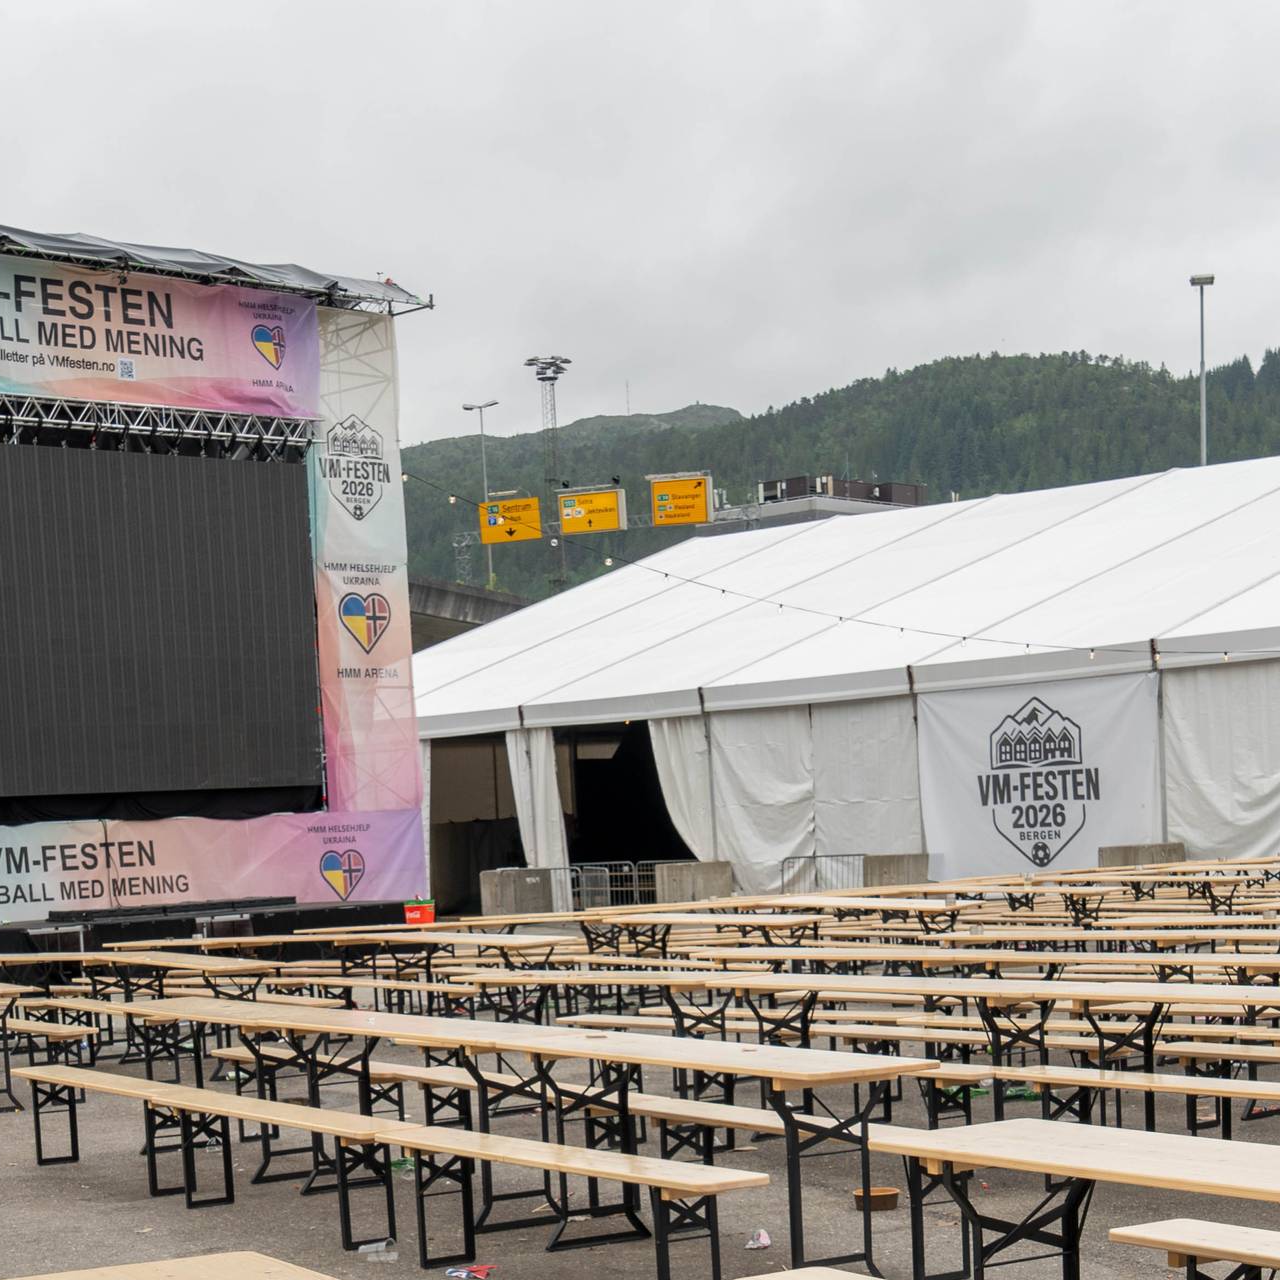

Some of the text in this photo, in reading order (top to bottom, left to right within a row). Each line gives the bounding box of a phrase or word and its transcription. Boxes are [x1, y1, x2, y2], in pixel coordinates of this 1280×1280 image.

[37, 320, 96, 350] MED
[105, 328, 204, 362] MENING
[32, 353, 45, 366] på
[47, 354, 116, 373] VMfesten.no
[319, 457, 391, 483] VM-FESTEN
[342, 480, 374, 497] 2026
[324, 562, 397, 574] HMM HELSEHJELP
[343, 576, 381, 586] UKRAINA
[337, 668, 398, 679] HMM ARENA
[977, 768, 1100, 806] VM-FESTEN
[1012, 803, 1066, 829] 2026
[307, 824, 370, 834] HMM HELSEHJELP
[1020, 830, 1061, 841] BERGEN
[323, 836, 356, 845] UKRAINA
[60, 879, 105, 901] MED
[112, 874, 190, 898] MENING
